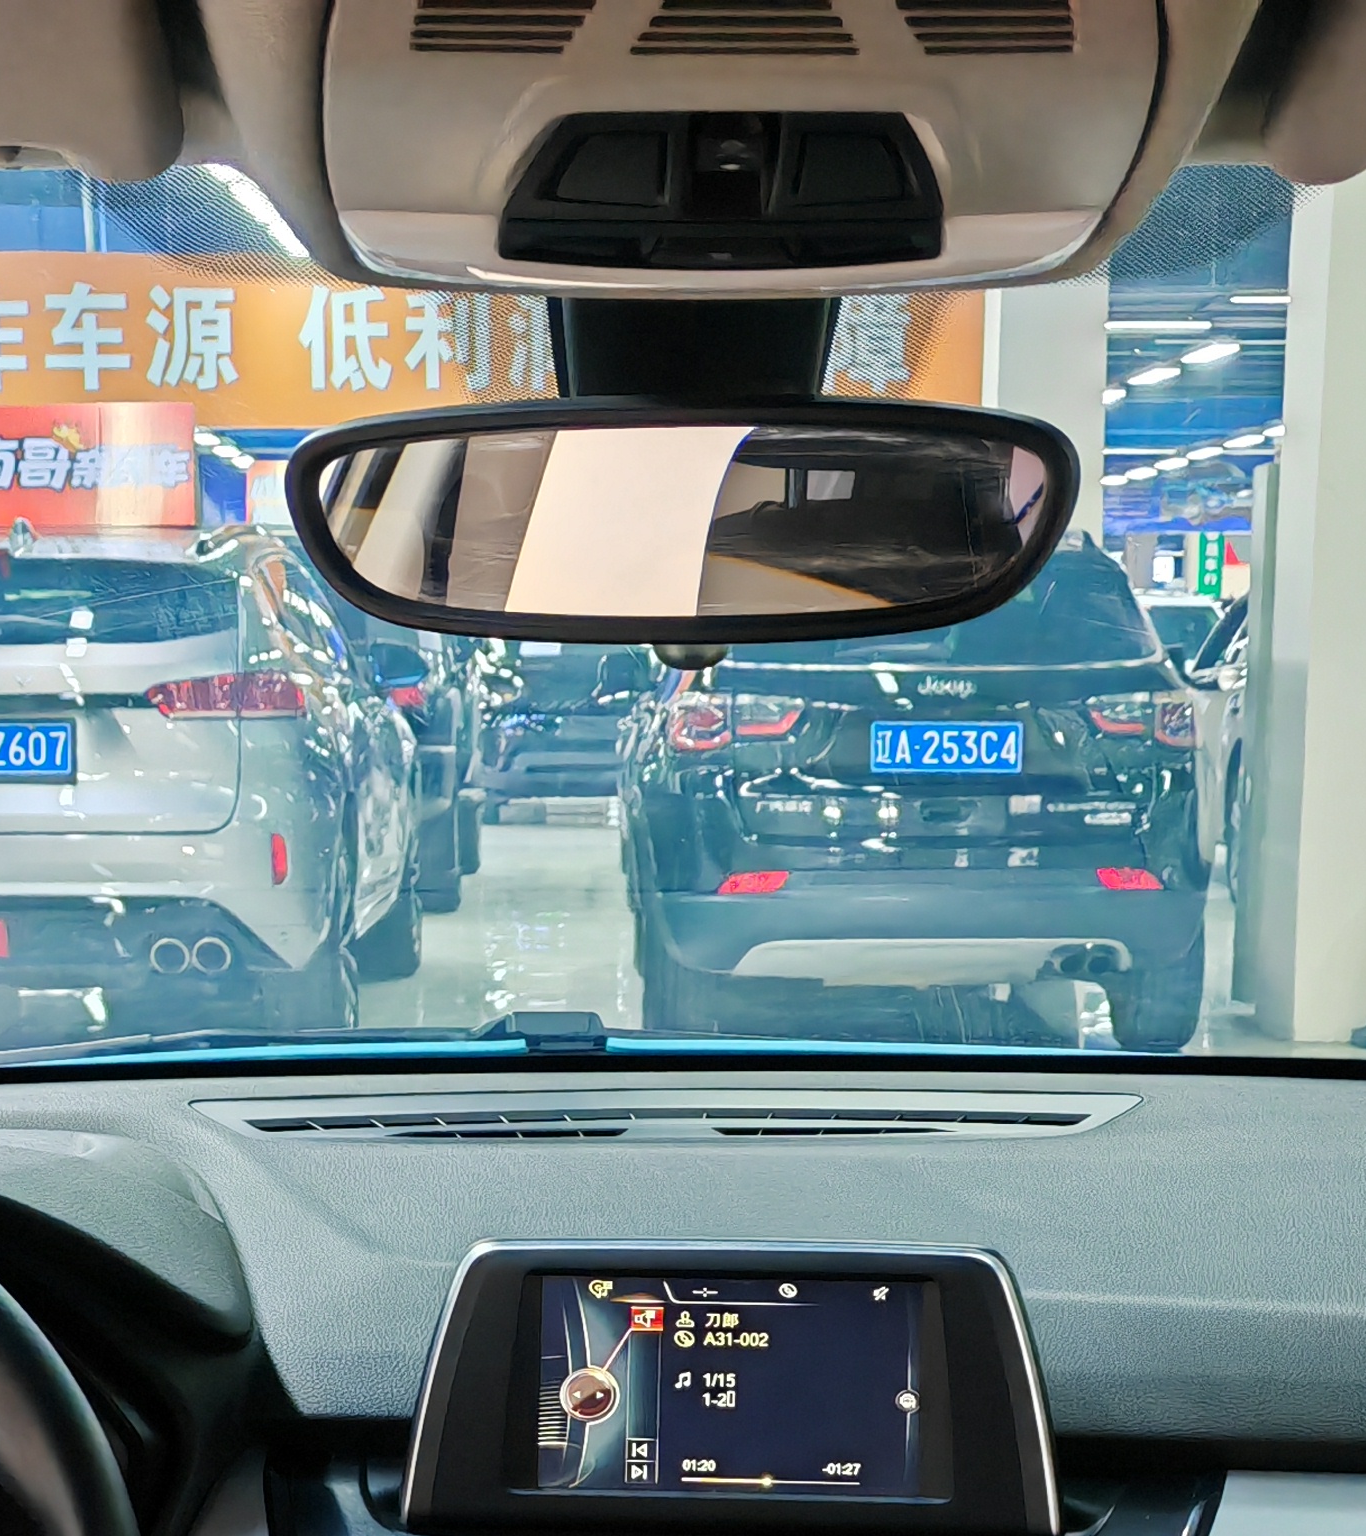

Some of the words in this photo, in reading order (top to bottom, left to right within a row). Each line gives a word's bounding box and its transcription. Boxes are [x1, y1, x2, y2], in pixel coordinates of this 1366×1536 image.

[703, 1332, 769, 1347] A31-002
[703, 1373, 736, 1388] 1/15
[681, 1459, 716, 1472] 01:20
[822, 1463, 861, 1476] -01:27
